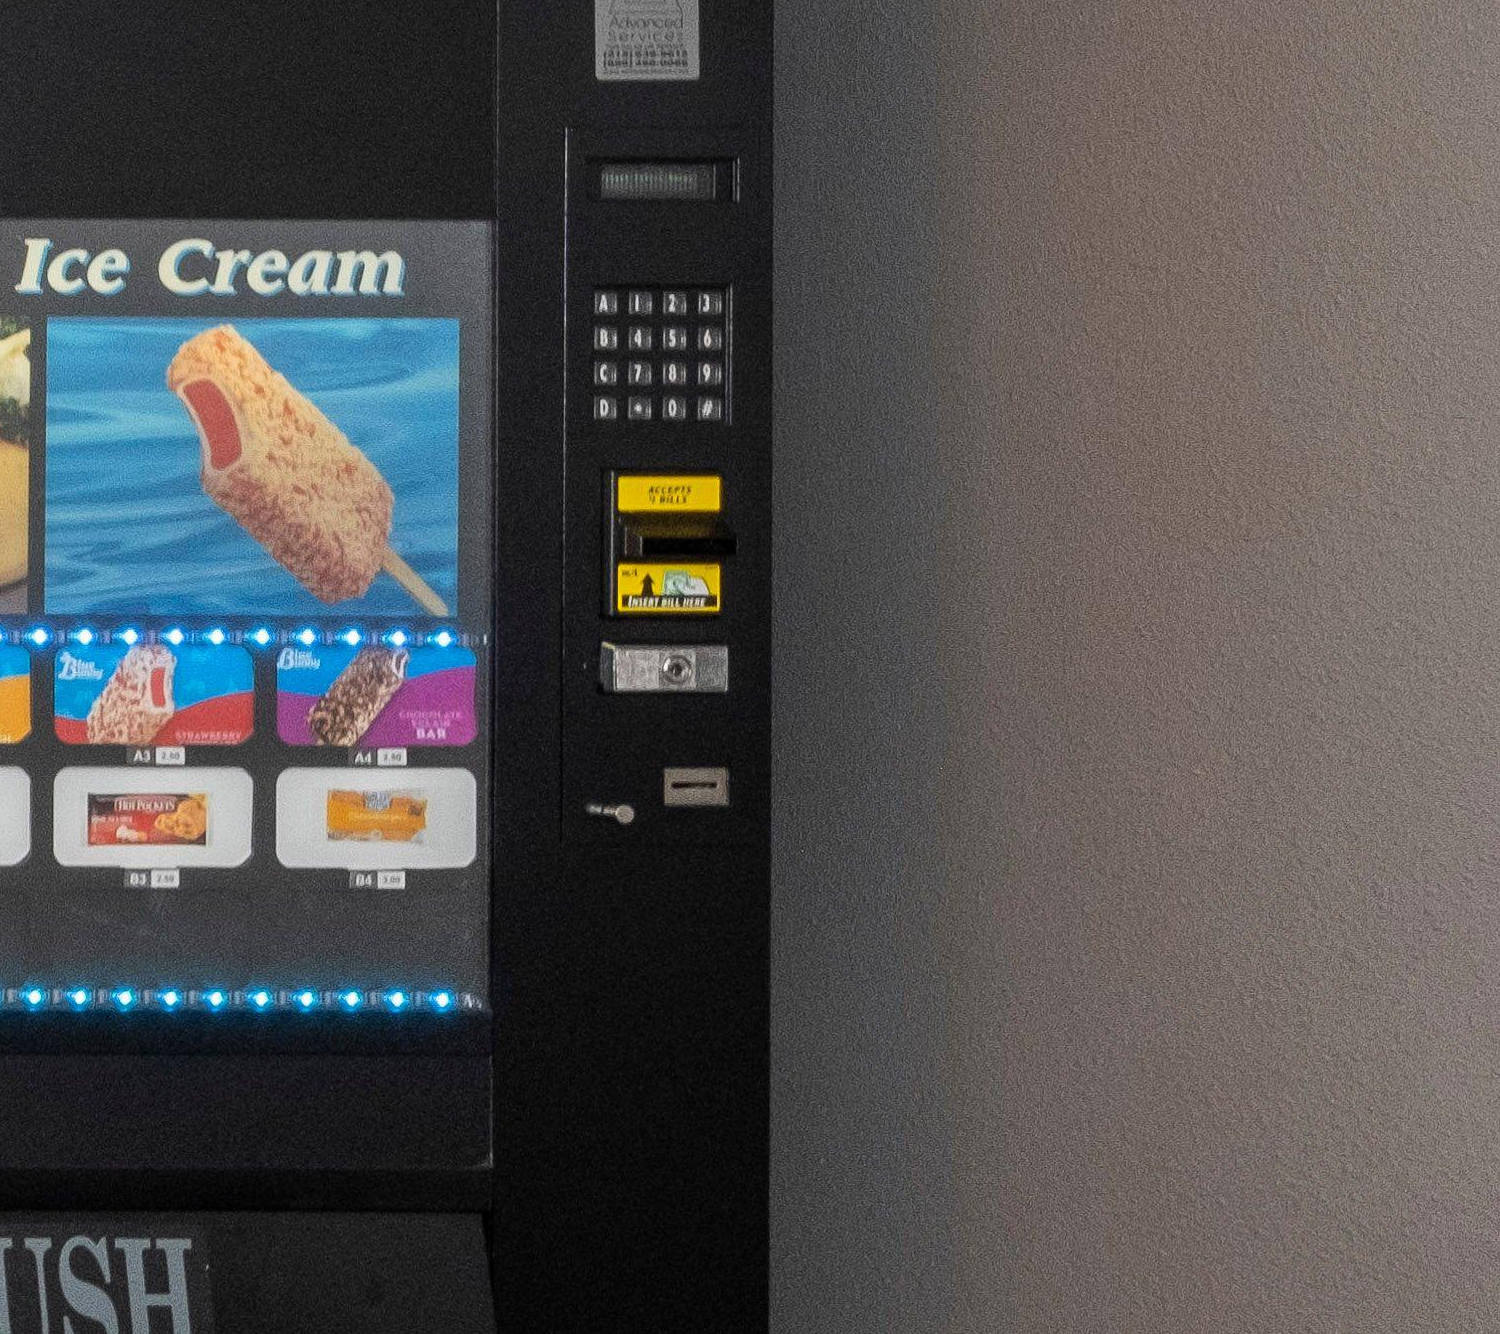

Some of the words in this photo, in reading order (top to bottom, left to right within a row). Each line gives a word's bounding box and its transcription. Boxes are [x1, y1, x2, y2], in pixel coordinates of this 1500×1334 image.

[15, 235, 129, 296] Ice
[157, 237, 407, 297] Cream
[648, 485, 692, 494] ACCEPTS
[659, 495, 688, 504] BILLS
[627, 595, 661, 608] INSERT
[662, 596, 683, 607] BILL
[683, 596, 707, 607] HERE
[415, 727, 447, 740] BAR
[133, 751, 150, 762] A3
